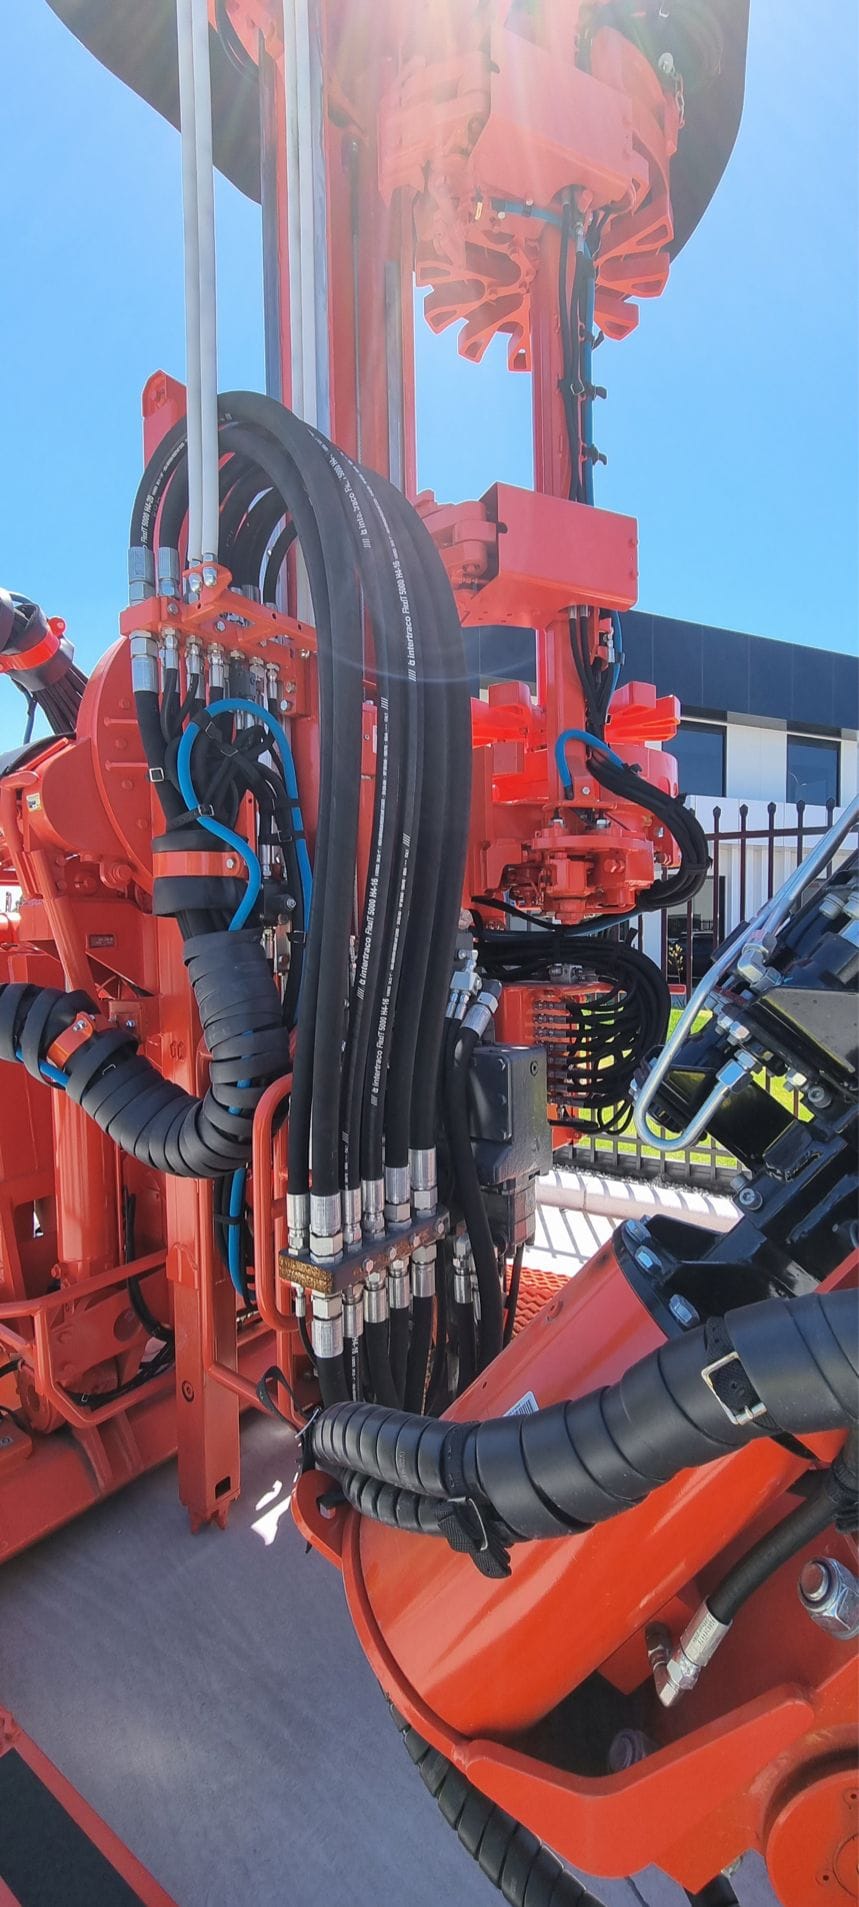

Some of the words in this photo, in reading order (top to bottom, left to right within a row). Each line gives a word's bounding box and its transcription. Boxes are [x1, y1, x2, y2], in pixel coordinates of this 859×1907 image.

[369, 878, 379, 898] H4-16
[367, 898, 377, 916] 5000
[360, 936, 372, 979] intertraco
